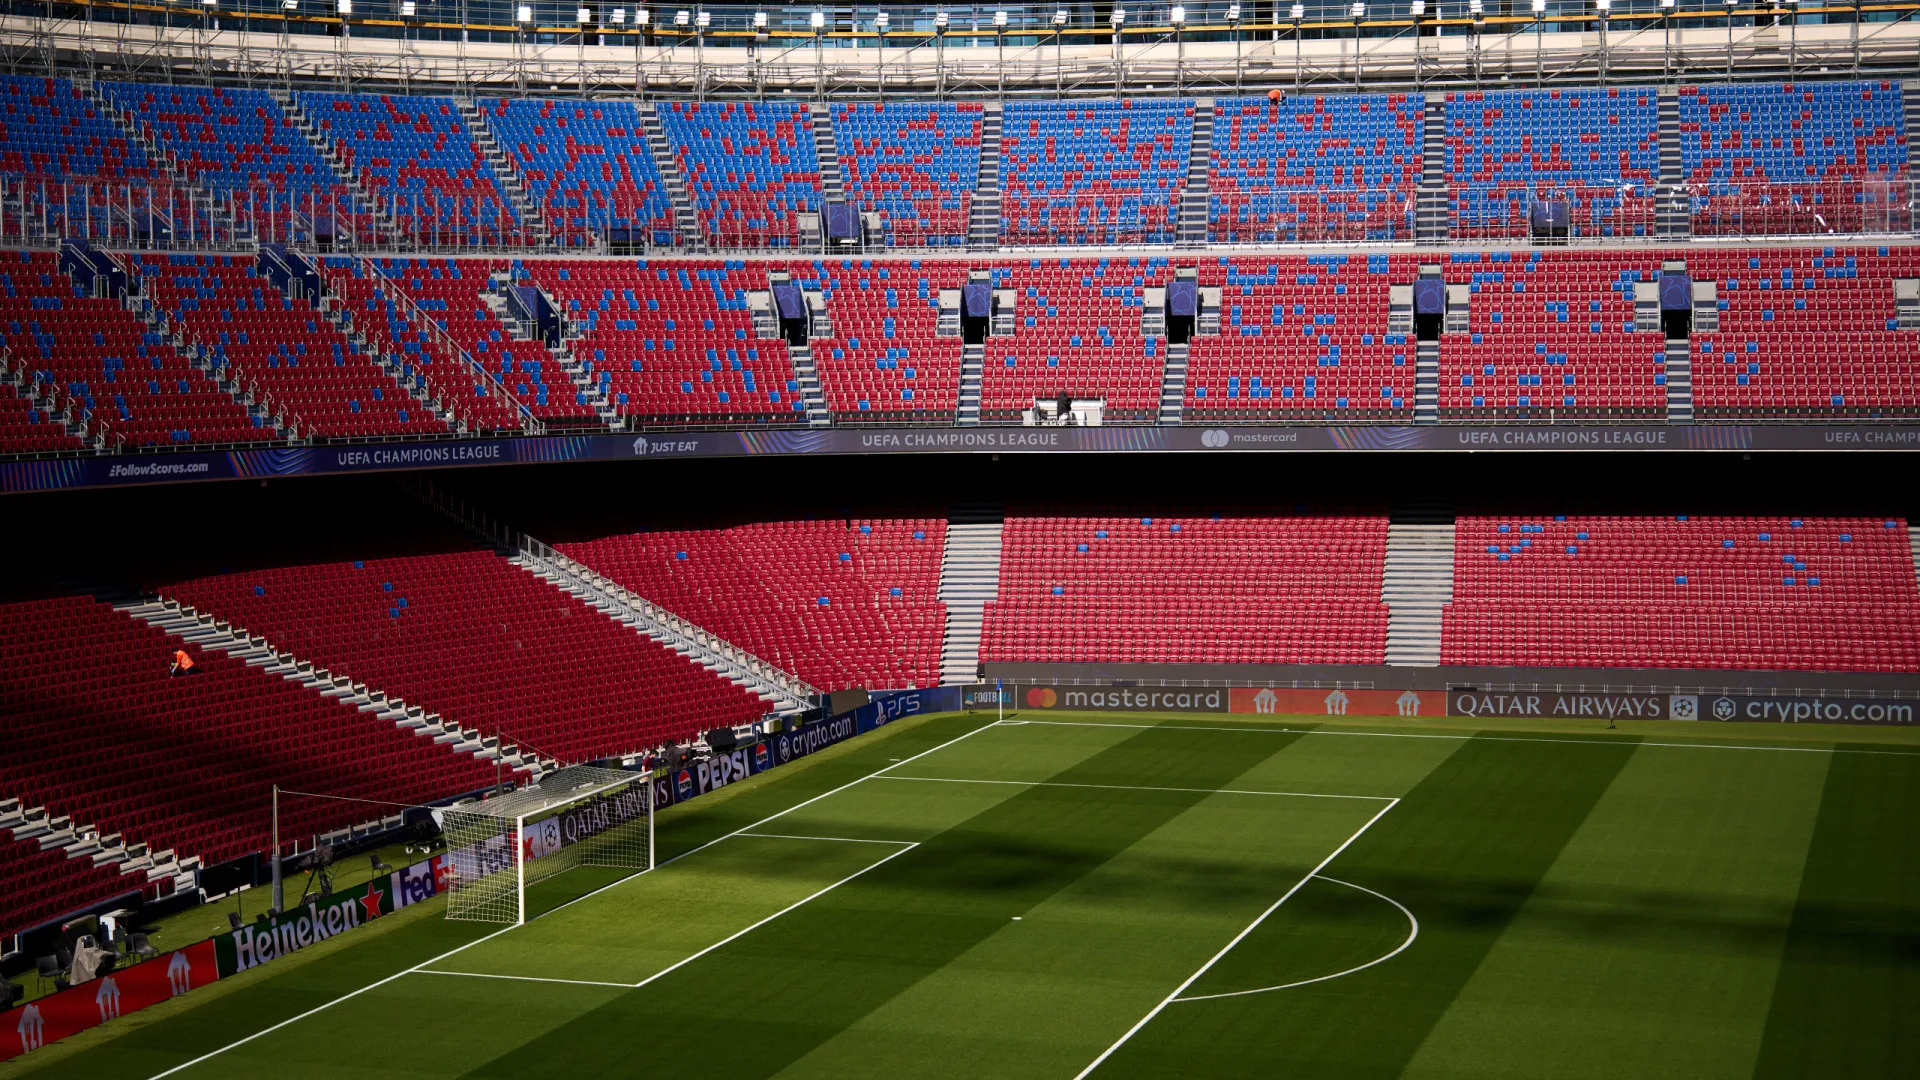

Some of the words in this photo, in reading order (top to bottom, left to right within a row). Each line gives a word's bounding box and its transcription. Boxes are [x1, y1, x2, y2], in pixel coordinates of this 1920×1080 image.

[650, 441, 676, 454] JUST
[678, 440, 698, 453] EAT
[862, 434, 900, 446] UEFA
[905, 434, 995, 446] CHAMPIONS
[1000, 433, 1058, 445] LEAGUE
[1233, 432, 1297, 443] mastercard
[1459, 432, 1499, 444] UEFA
[1503, 432, 1600, 444] CHAMPIONS
[1604, 431, 1666, 443] LEAGUE
[1825, 432, 1860, 443] UEFA
[338, 451, 371, 465] UEFA
[374, 447, 450, 464] CHAMPIONS
[453, 445, 500, 461] LEAGUE
[887, 694, 920, 719] PS5
[1064, 689, 1220, 708] mastercard
[1456, 694, 1542, 717] QATAR
[1552, 696, 1661, 717] AIRWAYS
[1746, 700, 1912, 722] crypto.com
[792, 716, 852, 755] crypto.com
[697, 749, 750, 795] PEPSI
[565, 802, 610, 843] QATAR
[615, 780, 668, 823] AIRWYS
[232, 898, 360, 973] Heineken
